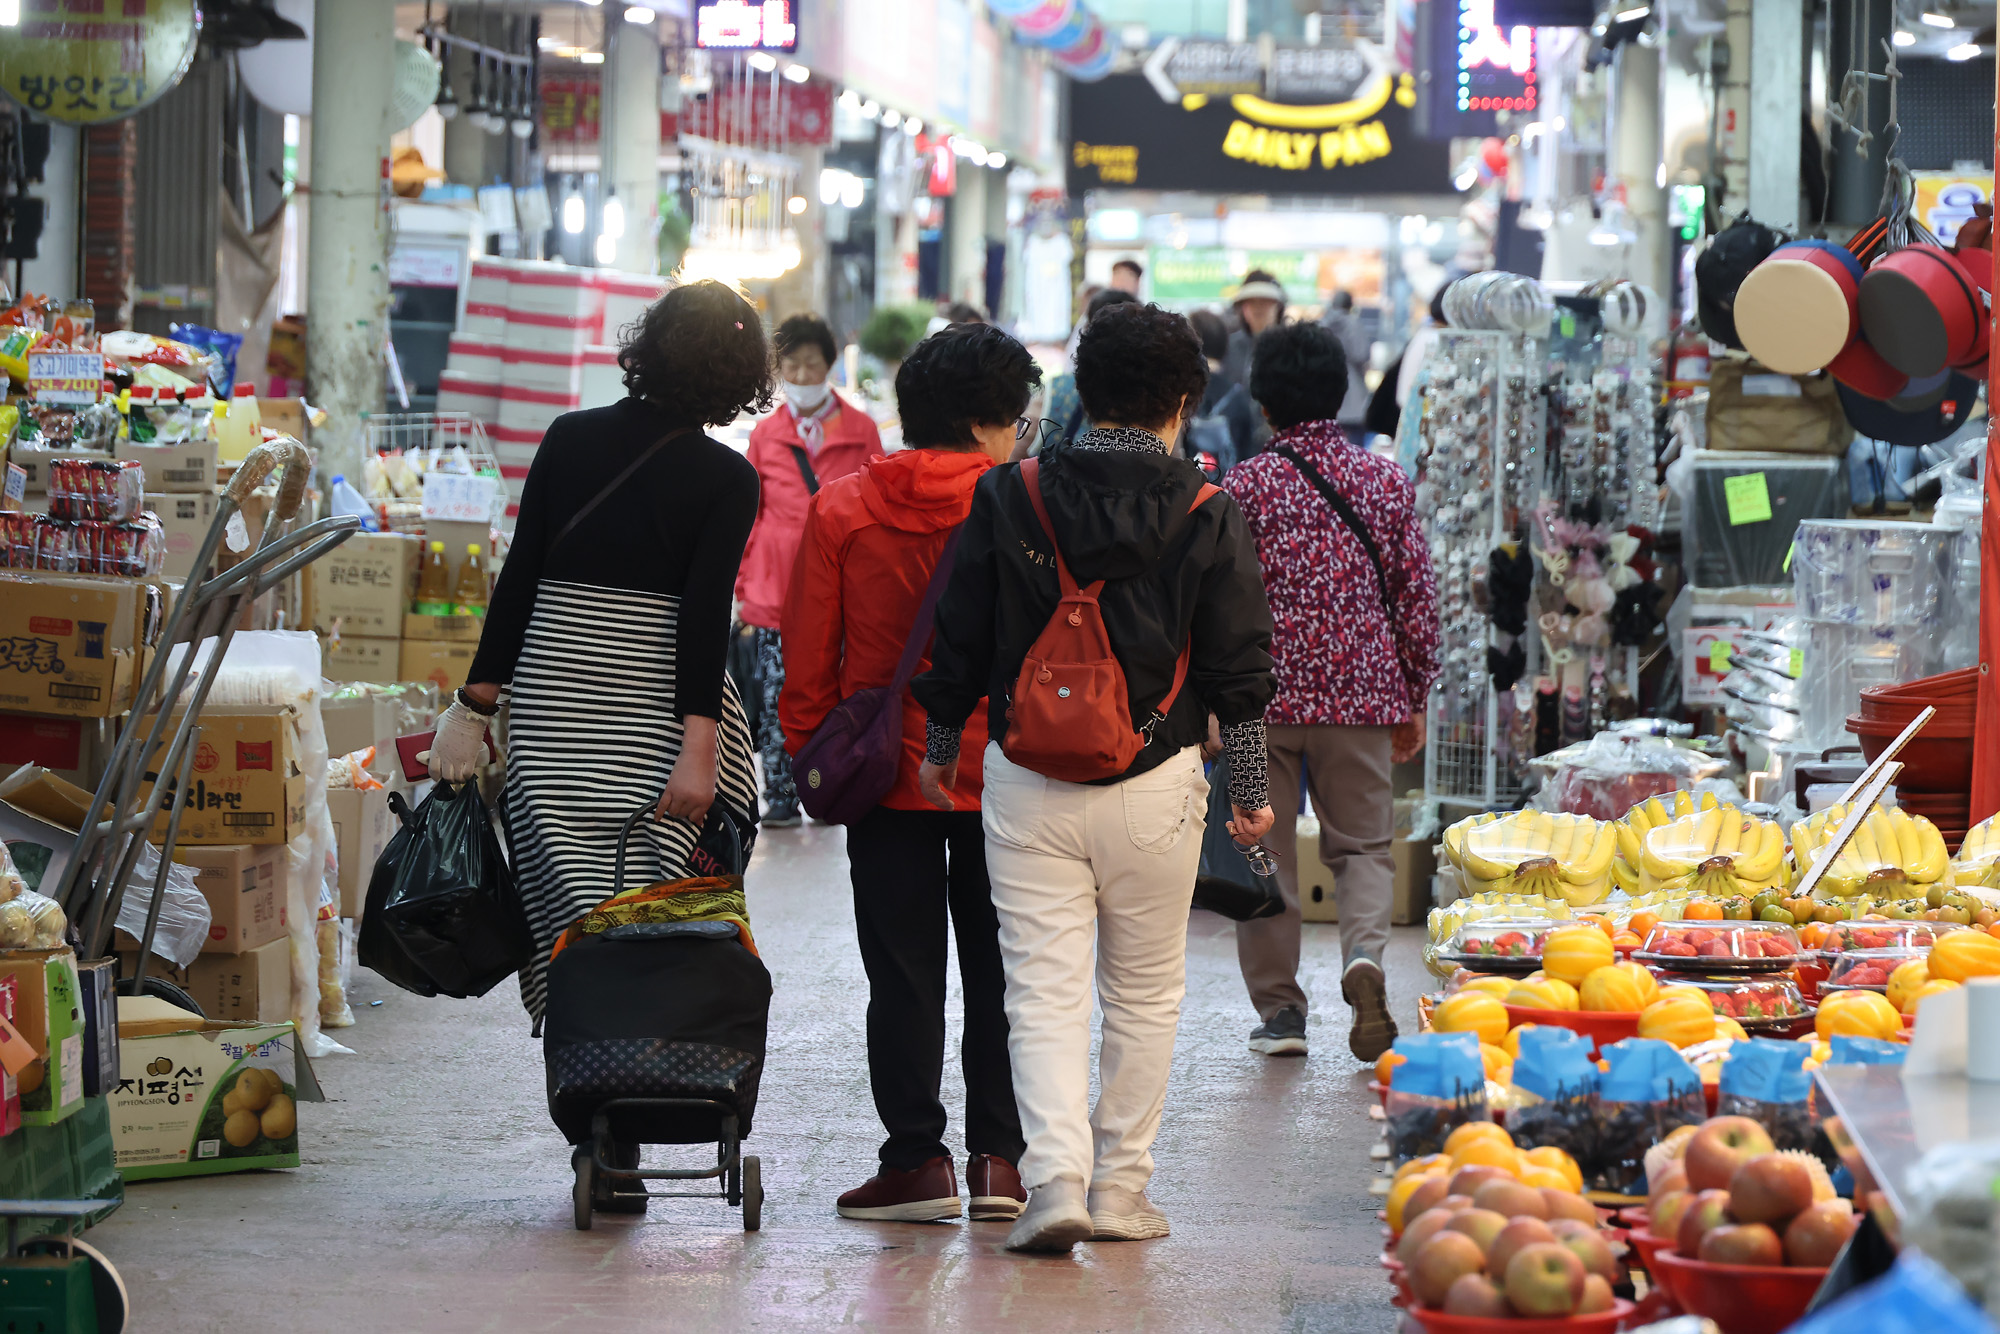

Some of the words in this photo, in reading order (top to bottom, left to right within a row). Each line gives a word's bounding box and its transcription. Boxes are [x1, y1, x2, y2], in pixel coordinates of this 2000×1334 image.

[19, 75, 147, 111] 방앗간
[1222, 119, 1318, 170] DAILY
[33, 354, 101, 377] 소고기미역국
[113, 1066, 204, 1106] 지평선
